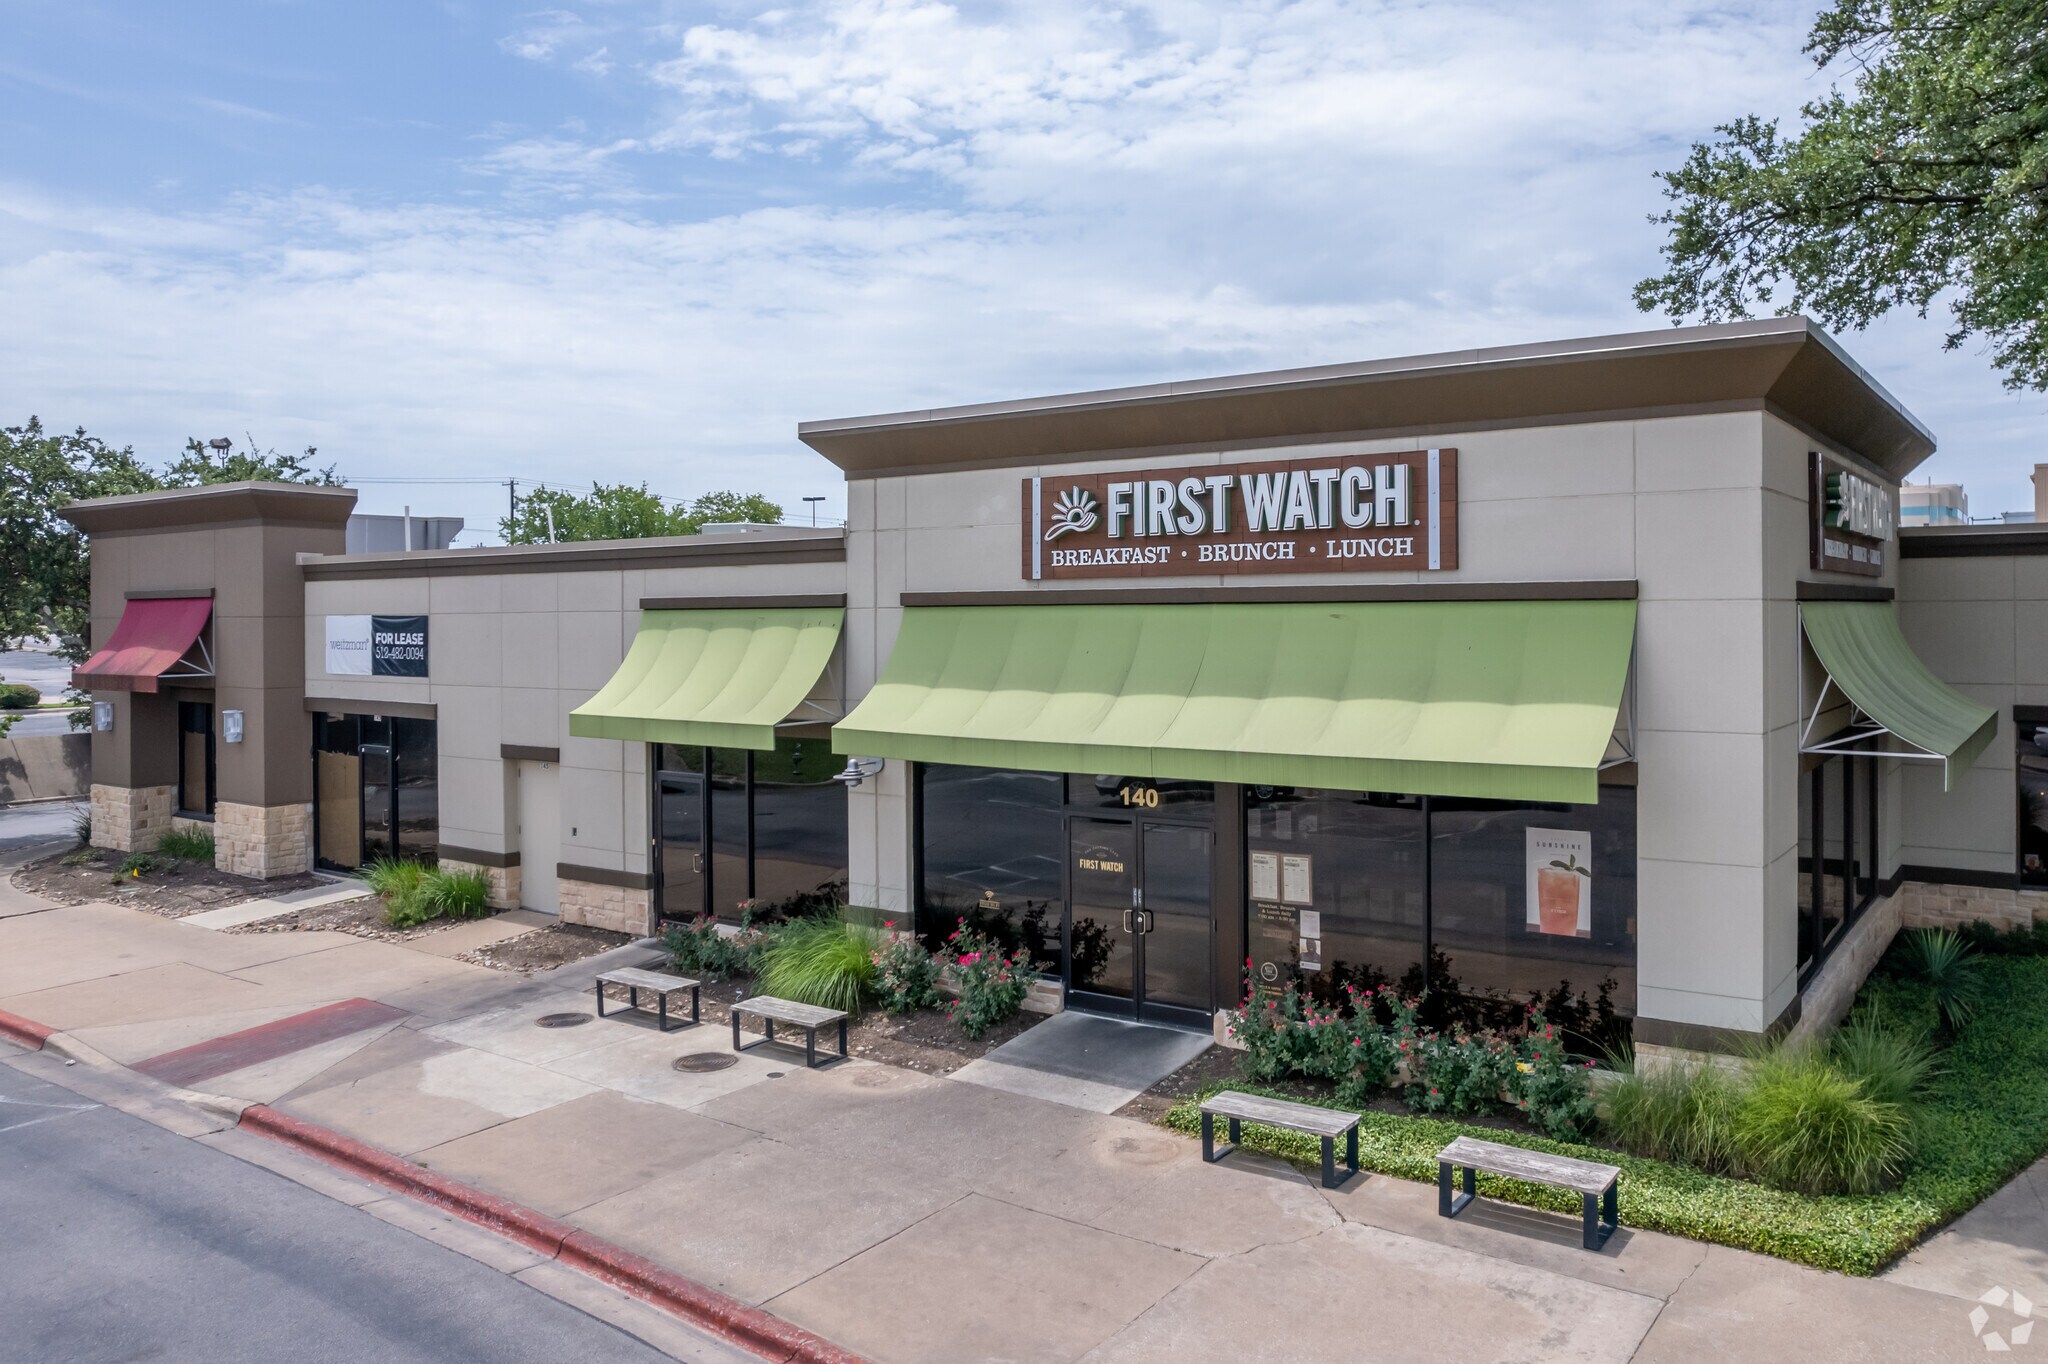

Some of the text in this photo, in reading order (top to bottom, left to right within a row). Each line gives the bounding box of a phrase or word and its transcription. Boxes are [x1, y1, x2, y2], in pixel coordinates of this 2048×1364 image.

[1107, 463, 1412, 539] FIRST WATCH
[1051, 537, 1414, 567] BREAKFAST BRUNCH LUNCH
[375, 632, 424, 645] FOR LEASE
[375, 646, 424, 660] 512-482-0094
[1120, 787, 1158, 807] 140
[1536, 841, 1581, 850] SUNSHINE
[1079, 858, 1124, 873] FIRST WATCH
